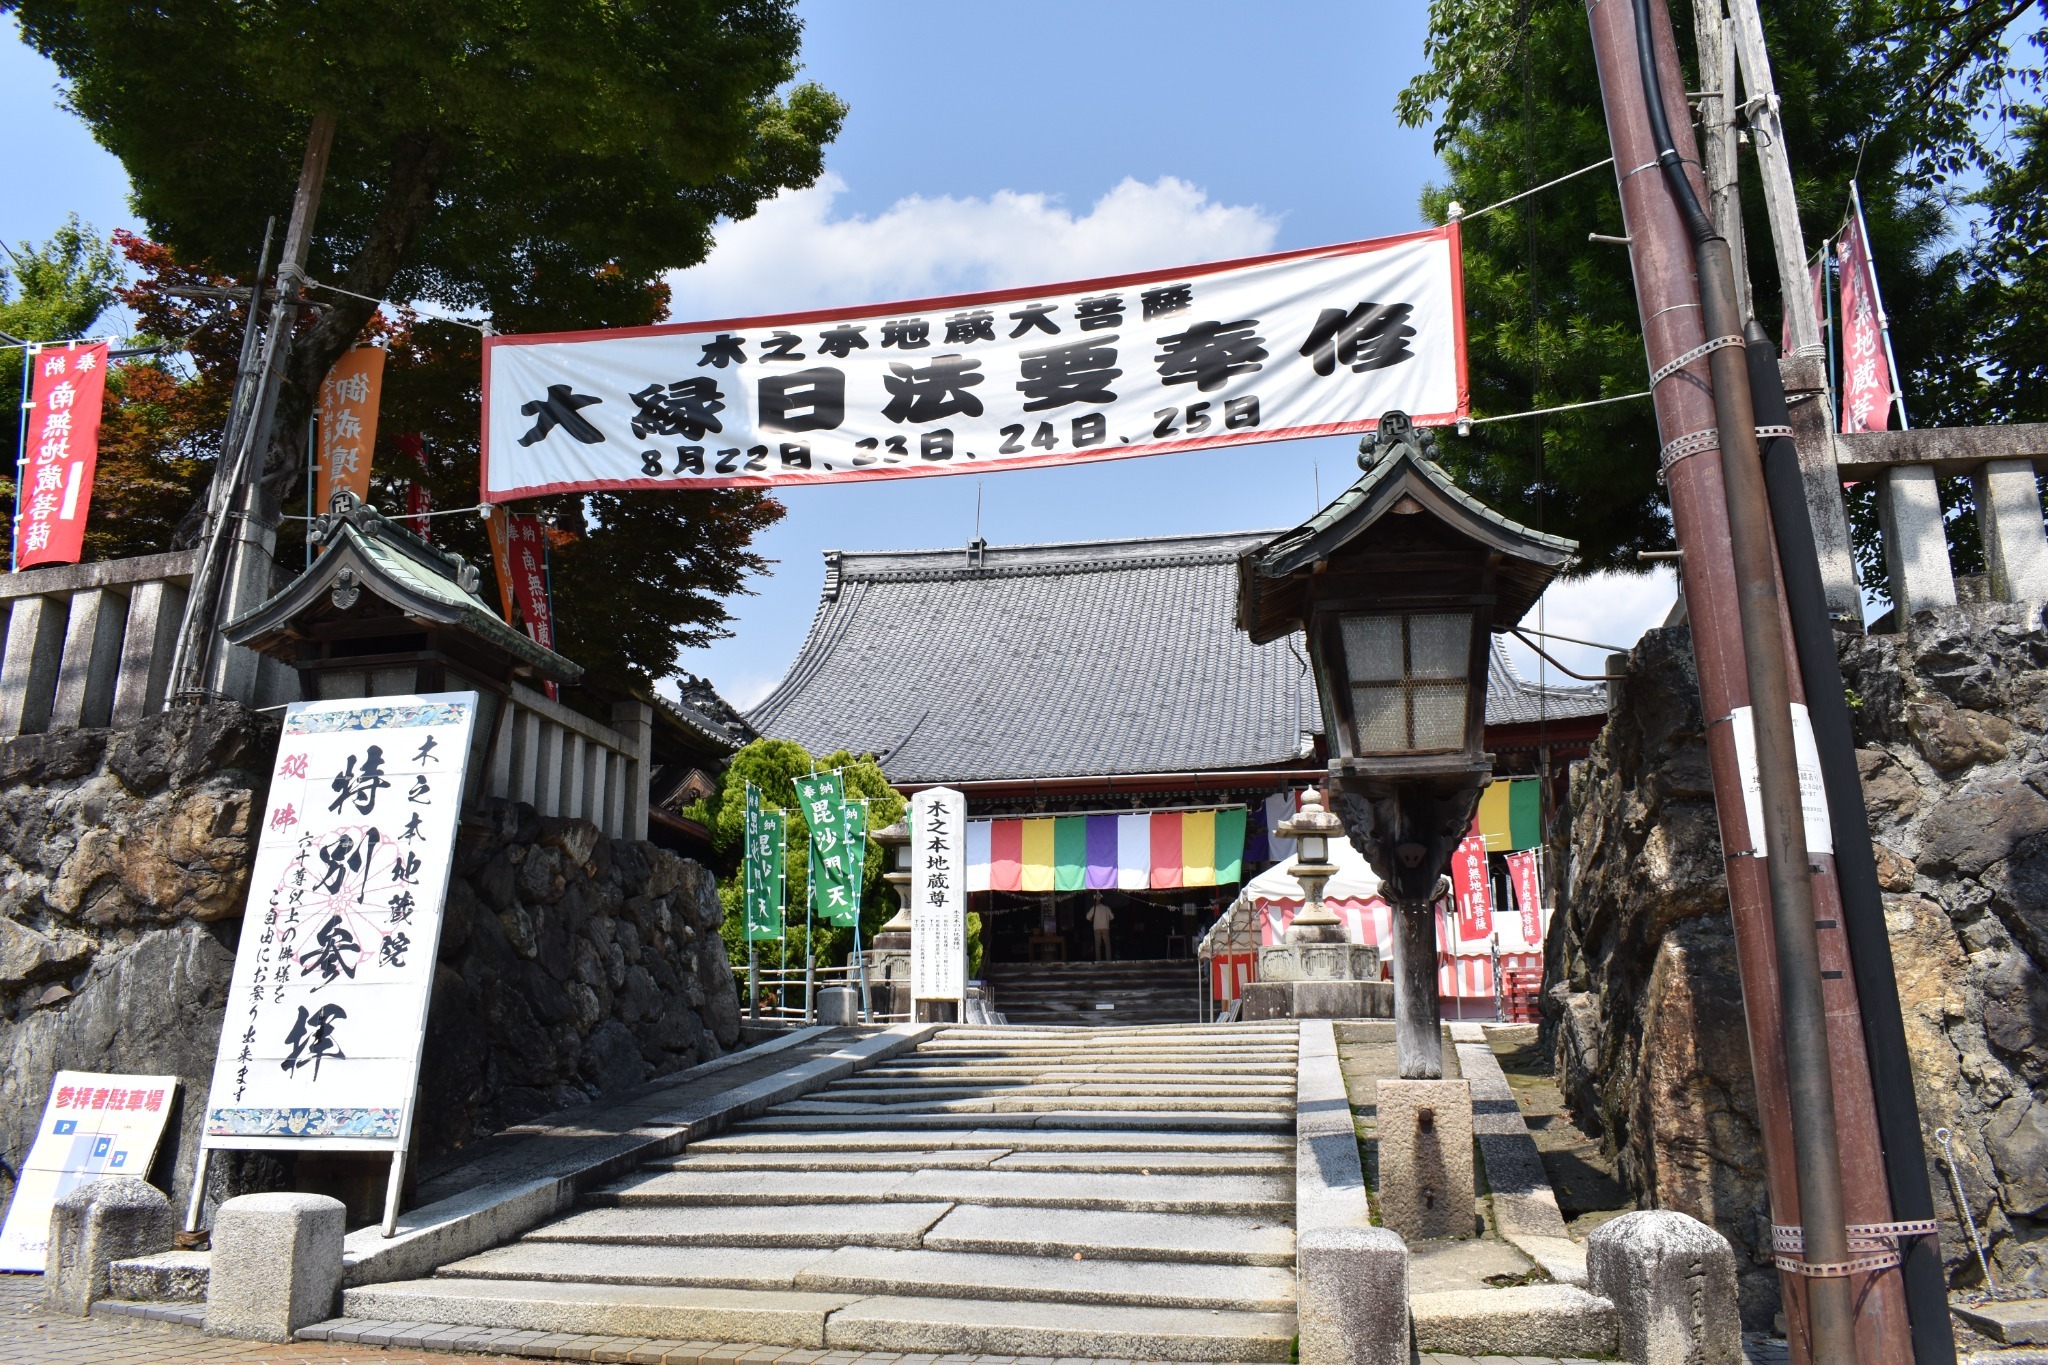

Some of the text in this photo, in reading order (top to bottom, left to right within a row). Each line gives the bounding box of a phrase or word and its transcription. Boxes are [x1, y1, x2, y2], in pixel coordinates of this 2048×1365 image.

[517, 302, 1417, 447] 大縁日法要奉修
[696, 282, 1193, 369] 木之本地蔵大菩薩
[521, 547, 551, 651] 南無地蔵
[803, 781, 834, 799] 奉納
[379, 734, 439, 968] 木之本地蔵院
[810, 799, 849, 908] 毘沙門天
[926, 801, 951, 908] 木之本地蔵尊
[1467, 855, 1488, 931] 南無地蔵菩薩
[273, 830, 314, 1004] 六十尊以上の佛様を
[280, 744, 391, 1082] 特別参拝
[232, 888, 284, 1106] ご自由にお参り出来ます
[55, 1086, 165, 1113] 参拝者駐車場
[61, 1123, 70, 1133] P
[98, 1143, 107, 1153] P
[115, 1154, 124, 1164] P
